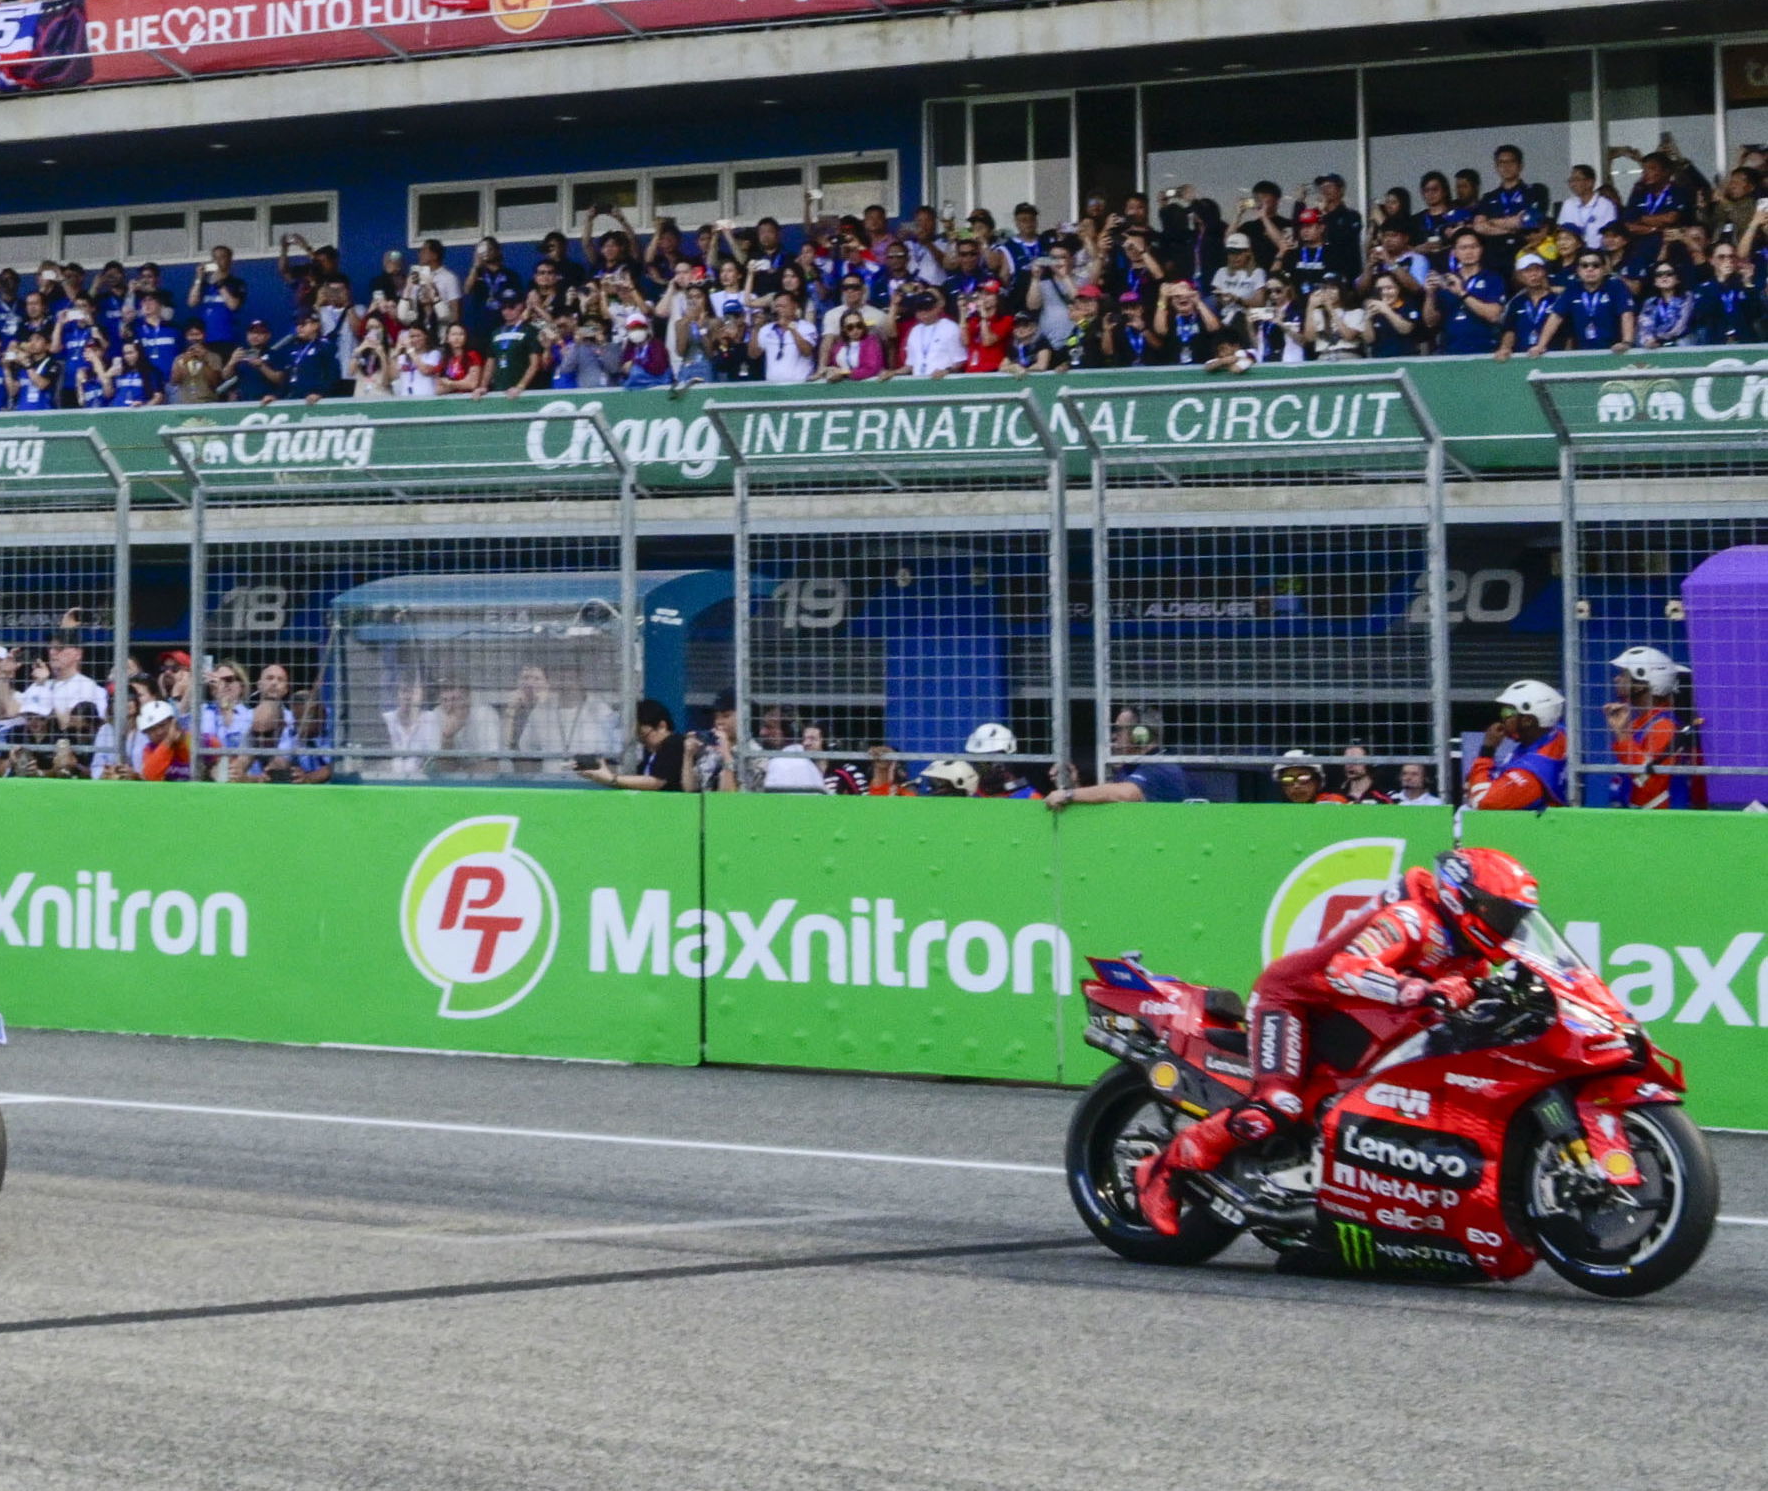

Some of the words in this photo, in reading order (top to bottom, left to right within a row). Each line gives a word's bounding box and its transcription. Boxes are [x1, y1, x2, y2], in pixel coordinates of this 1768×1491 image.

[234, 414, 373, 469] Chang
[527, 400, 720, 478] Chang
[1167, 392, 1401, 442] CIRCUIT
[1410, 569, 1524, 623] 20
[440, 864, 523, 975] PT
[590, 888, 1072, 997] Maxnitron
[1261, 1014, 1279, 1071] Lenovo
[1285, 1014, 1303, 1077] DUCATI
[1365, 1083, 1431, 1118] GIVI
[1343, 1125, 1468, 1179] Lenovo
[1360, 1171, 1461, 1209] NetApp
[1376, 1207, 1446, 1232] elica
